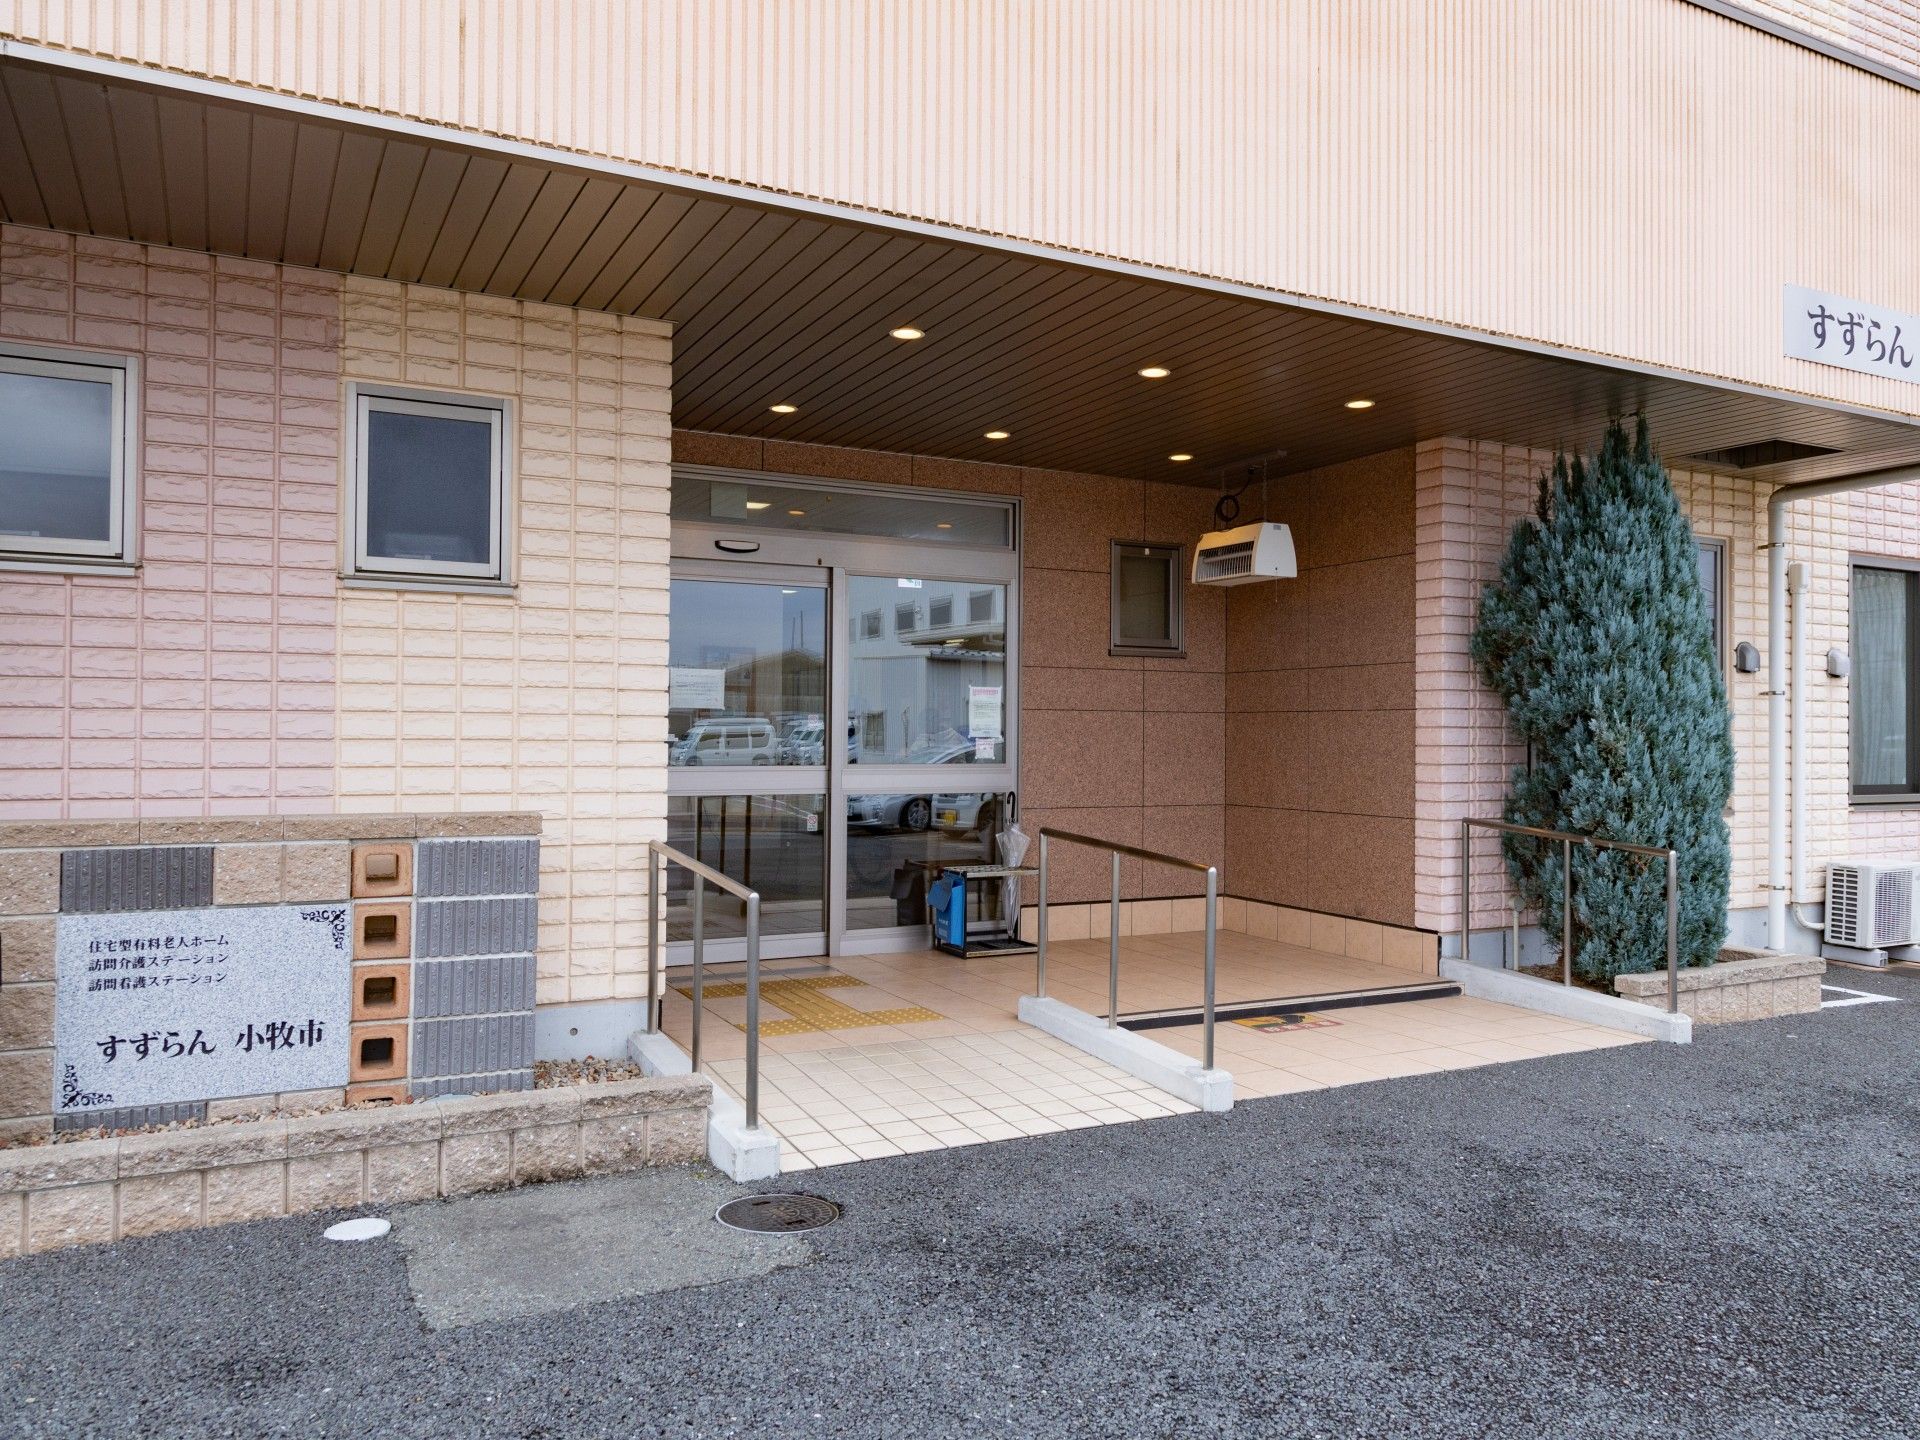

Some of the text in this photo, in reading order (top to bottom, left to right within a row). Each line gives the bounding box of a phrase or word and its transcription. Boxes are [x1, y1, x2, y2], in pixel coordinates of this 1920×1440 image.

[1807, 304, 1914, 368] すずらん
[88, 934, 229, 953] 住宅型有料老人ホーム
[88, 953, 229, 972] 訪問介護ステーション
[88, 973, 228, 992] 訪問看護ステーション
[96, 1018, 326, 1064] すずらん 小牧市
